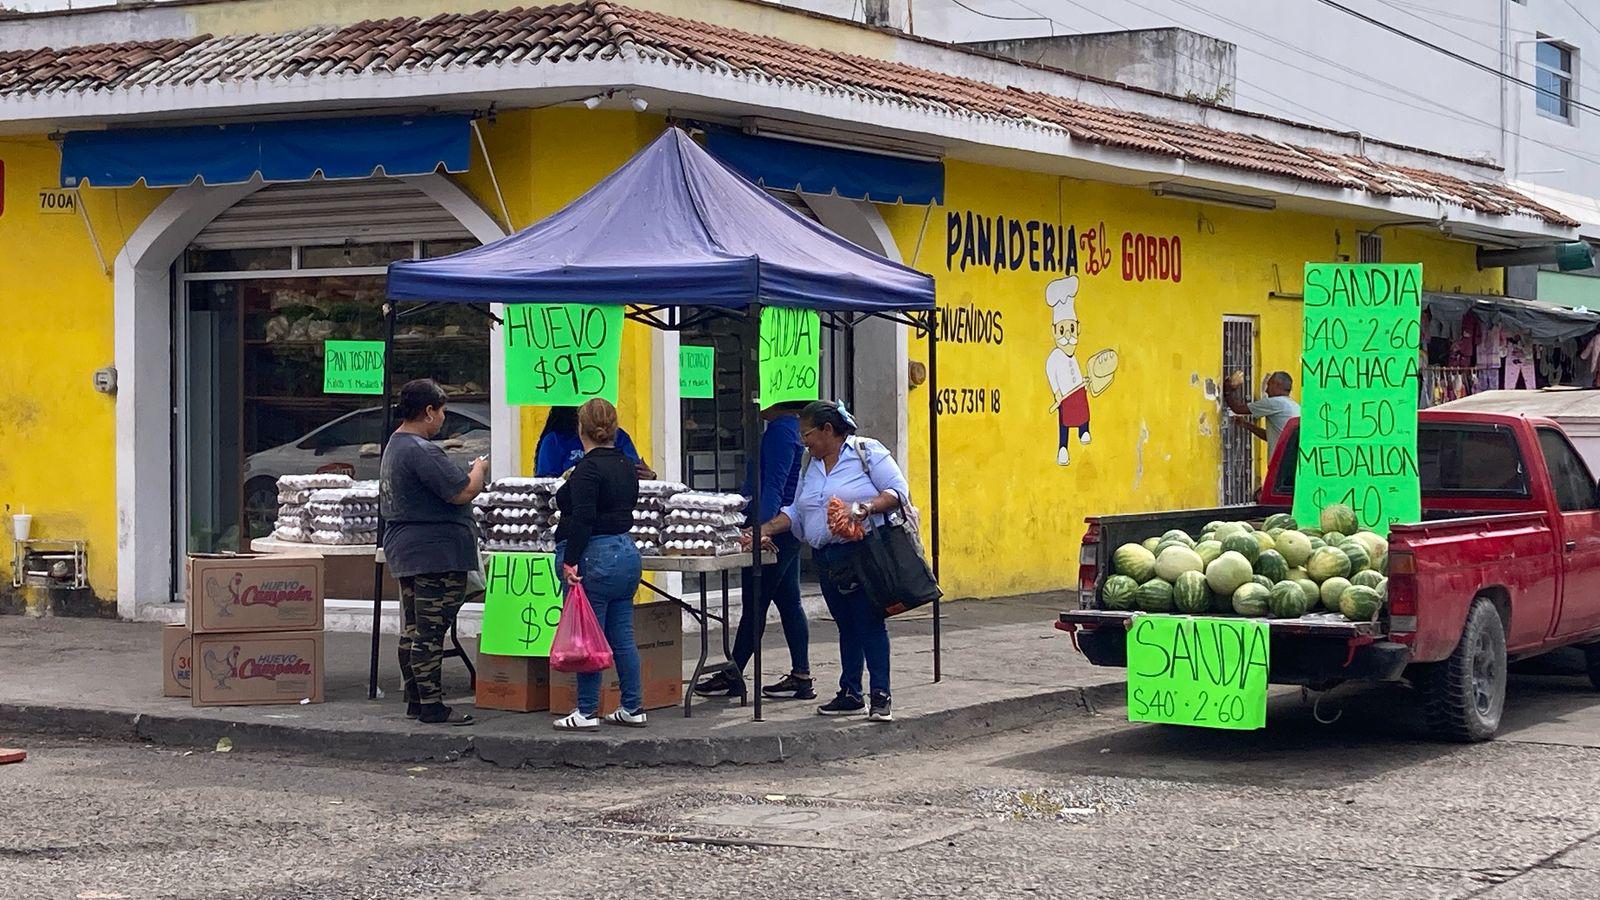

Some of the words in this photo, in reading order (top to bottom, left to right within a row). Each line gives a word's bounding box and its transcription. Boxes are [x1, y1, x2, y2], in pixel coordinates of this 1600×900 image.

[39, 193, 74, 209] 700A
[946, 210, 1079, 276] PANADERIA
[1080, 221, 1111, 276] El
[1121, 232, 1182, 283] GORDO
[1305, 268, 1420, 307] SANDIA
[507, 307, 607, 349] HUEVO
[916, 303, 1003, 345] BENVENIDOS
[327, 349, 347, 371] PAN
[349, 351, 385, 372] TOSTAD
[534, 354, 606, 395] $95
[1301, 356, 1420, 389] MACHACA
[1317, 400, 1395, 440] $150
[1299, 445, 1419, 477] MEDALLON
[260, 581, 300, 591] HUEVO
[490, 555, 563, 597] HUEV
[519, 602, 563, 649] $9
[257, 654, 298, 664] HUEVO
[1136, 620, 1268, 690] SANDIA
